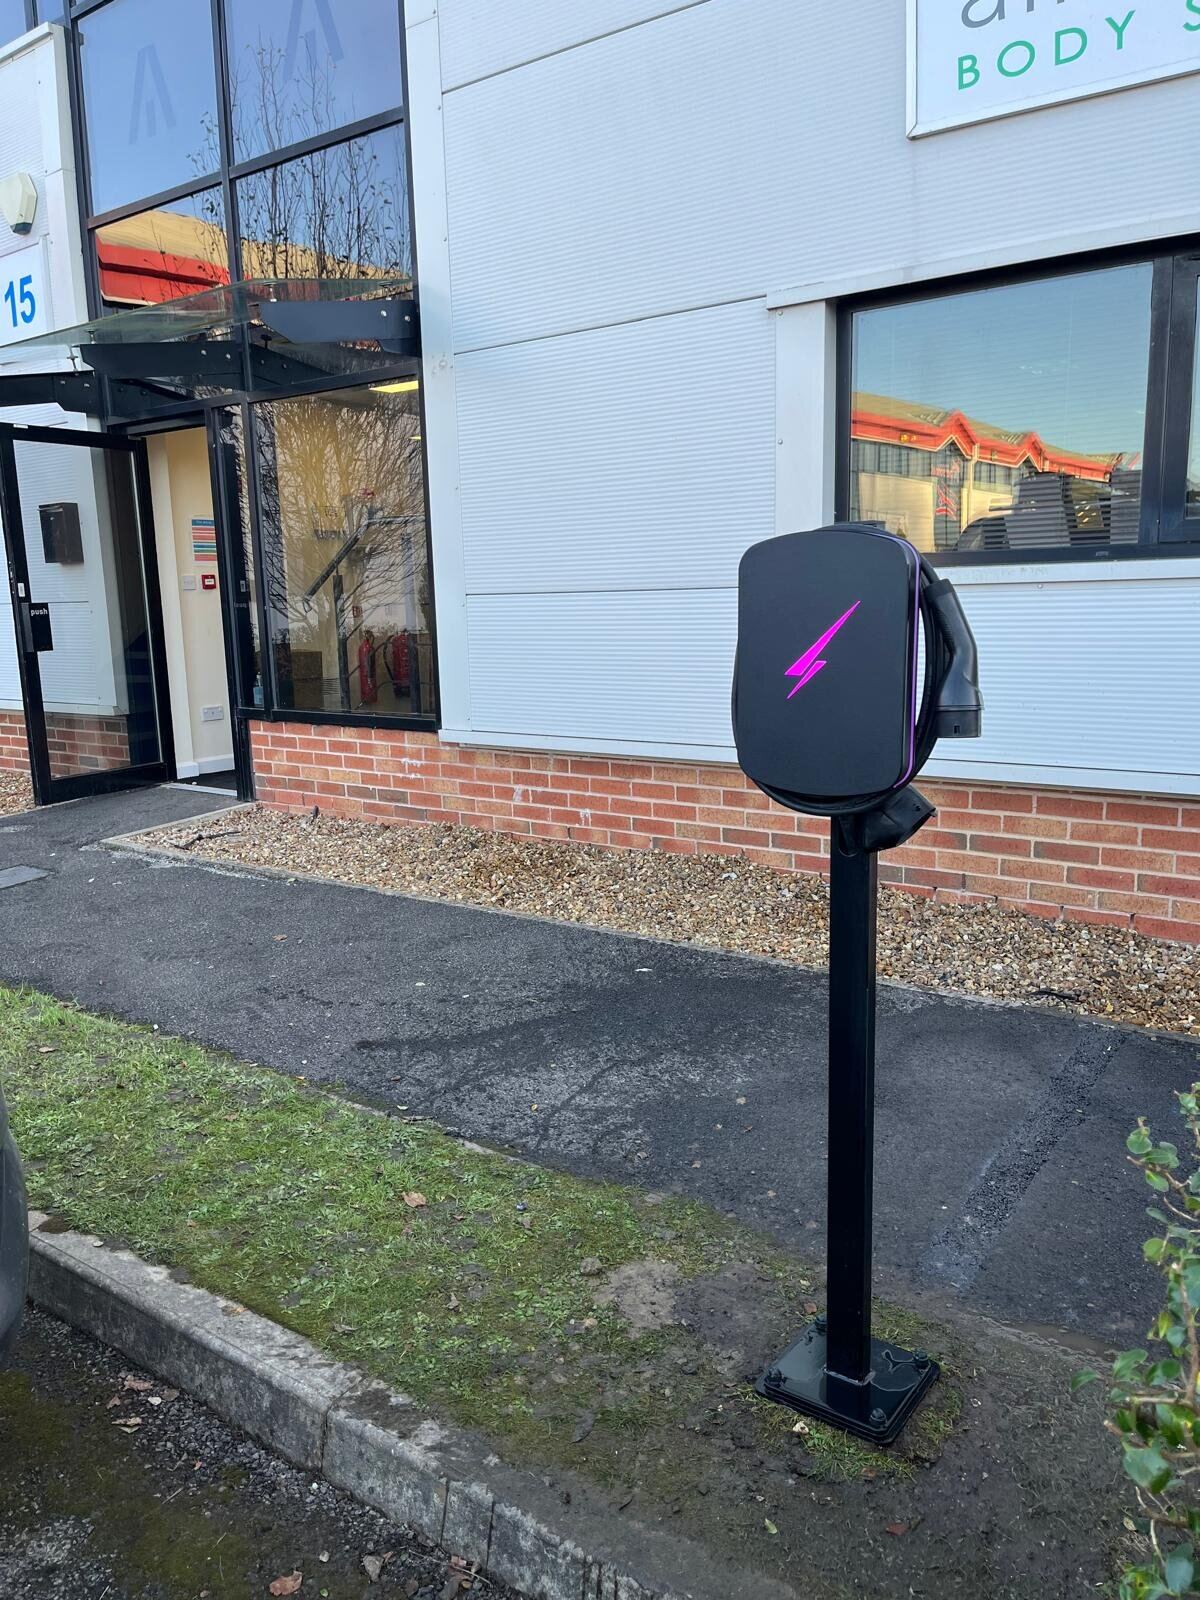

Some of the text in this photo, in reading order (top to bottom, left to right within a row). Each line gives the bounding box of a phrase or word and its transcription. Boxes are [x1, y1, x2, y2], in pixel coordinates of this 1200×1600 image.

[957, 10, 1136, 90] BODY
[4, 274, 36, 328] 15
[30, 608, 48, 617] push
